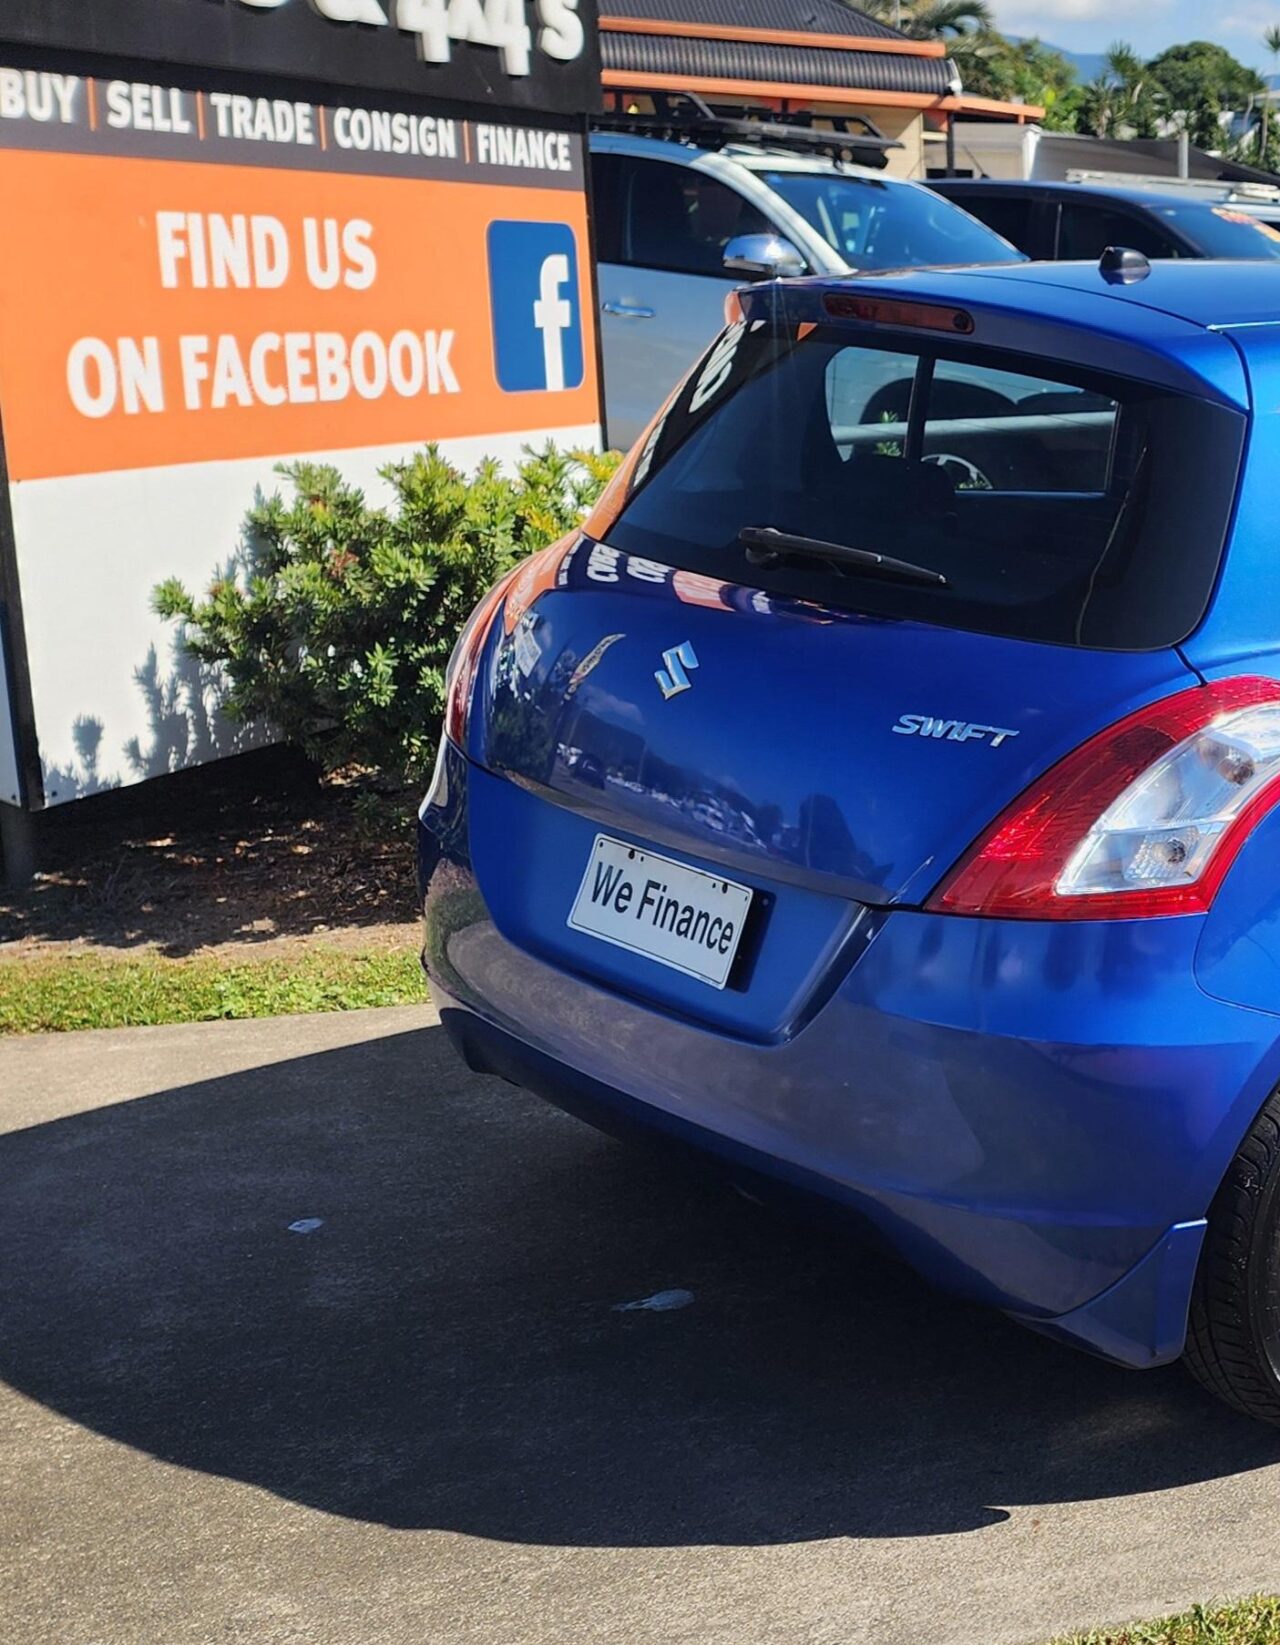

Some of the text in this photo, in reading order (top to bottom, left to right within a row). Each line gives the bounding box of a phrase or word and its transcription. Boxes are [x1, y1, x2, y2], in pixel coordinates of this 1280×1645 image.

[0, 67, 571, 171] BUY SELL TRADE CONSIGN FINANCE
[157, 211, 376, 290] FIND US
[66, 329, 461, 418] ON FACEBOOK
[892, 713, 1020, 748] SWIFT
[591, 861, 735, 955] We Finance
